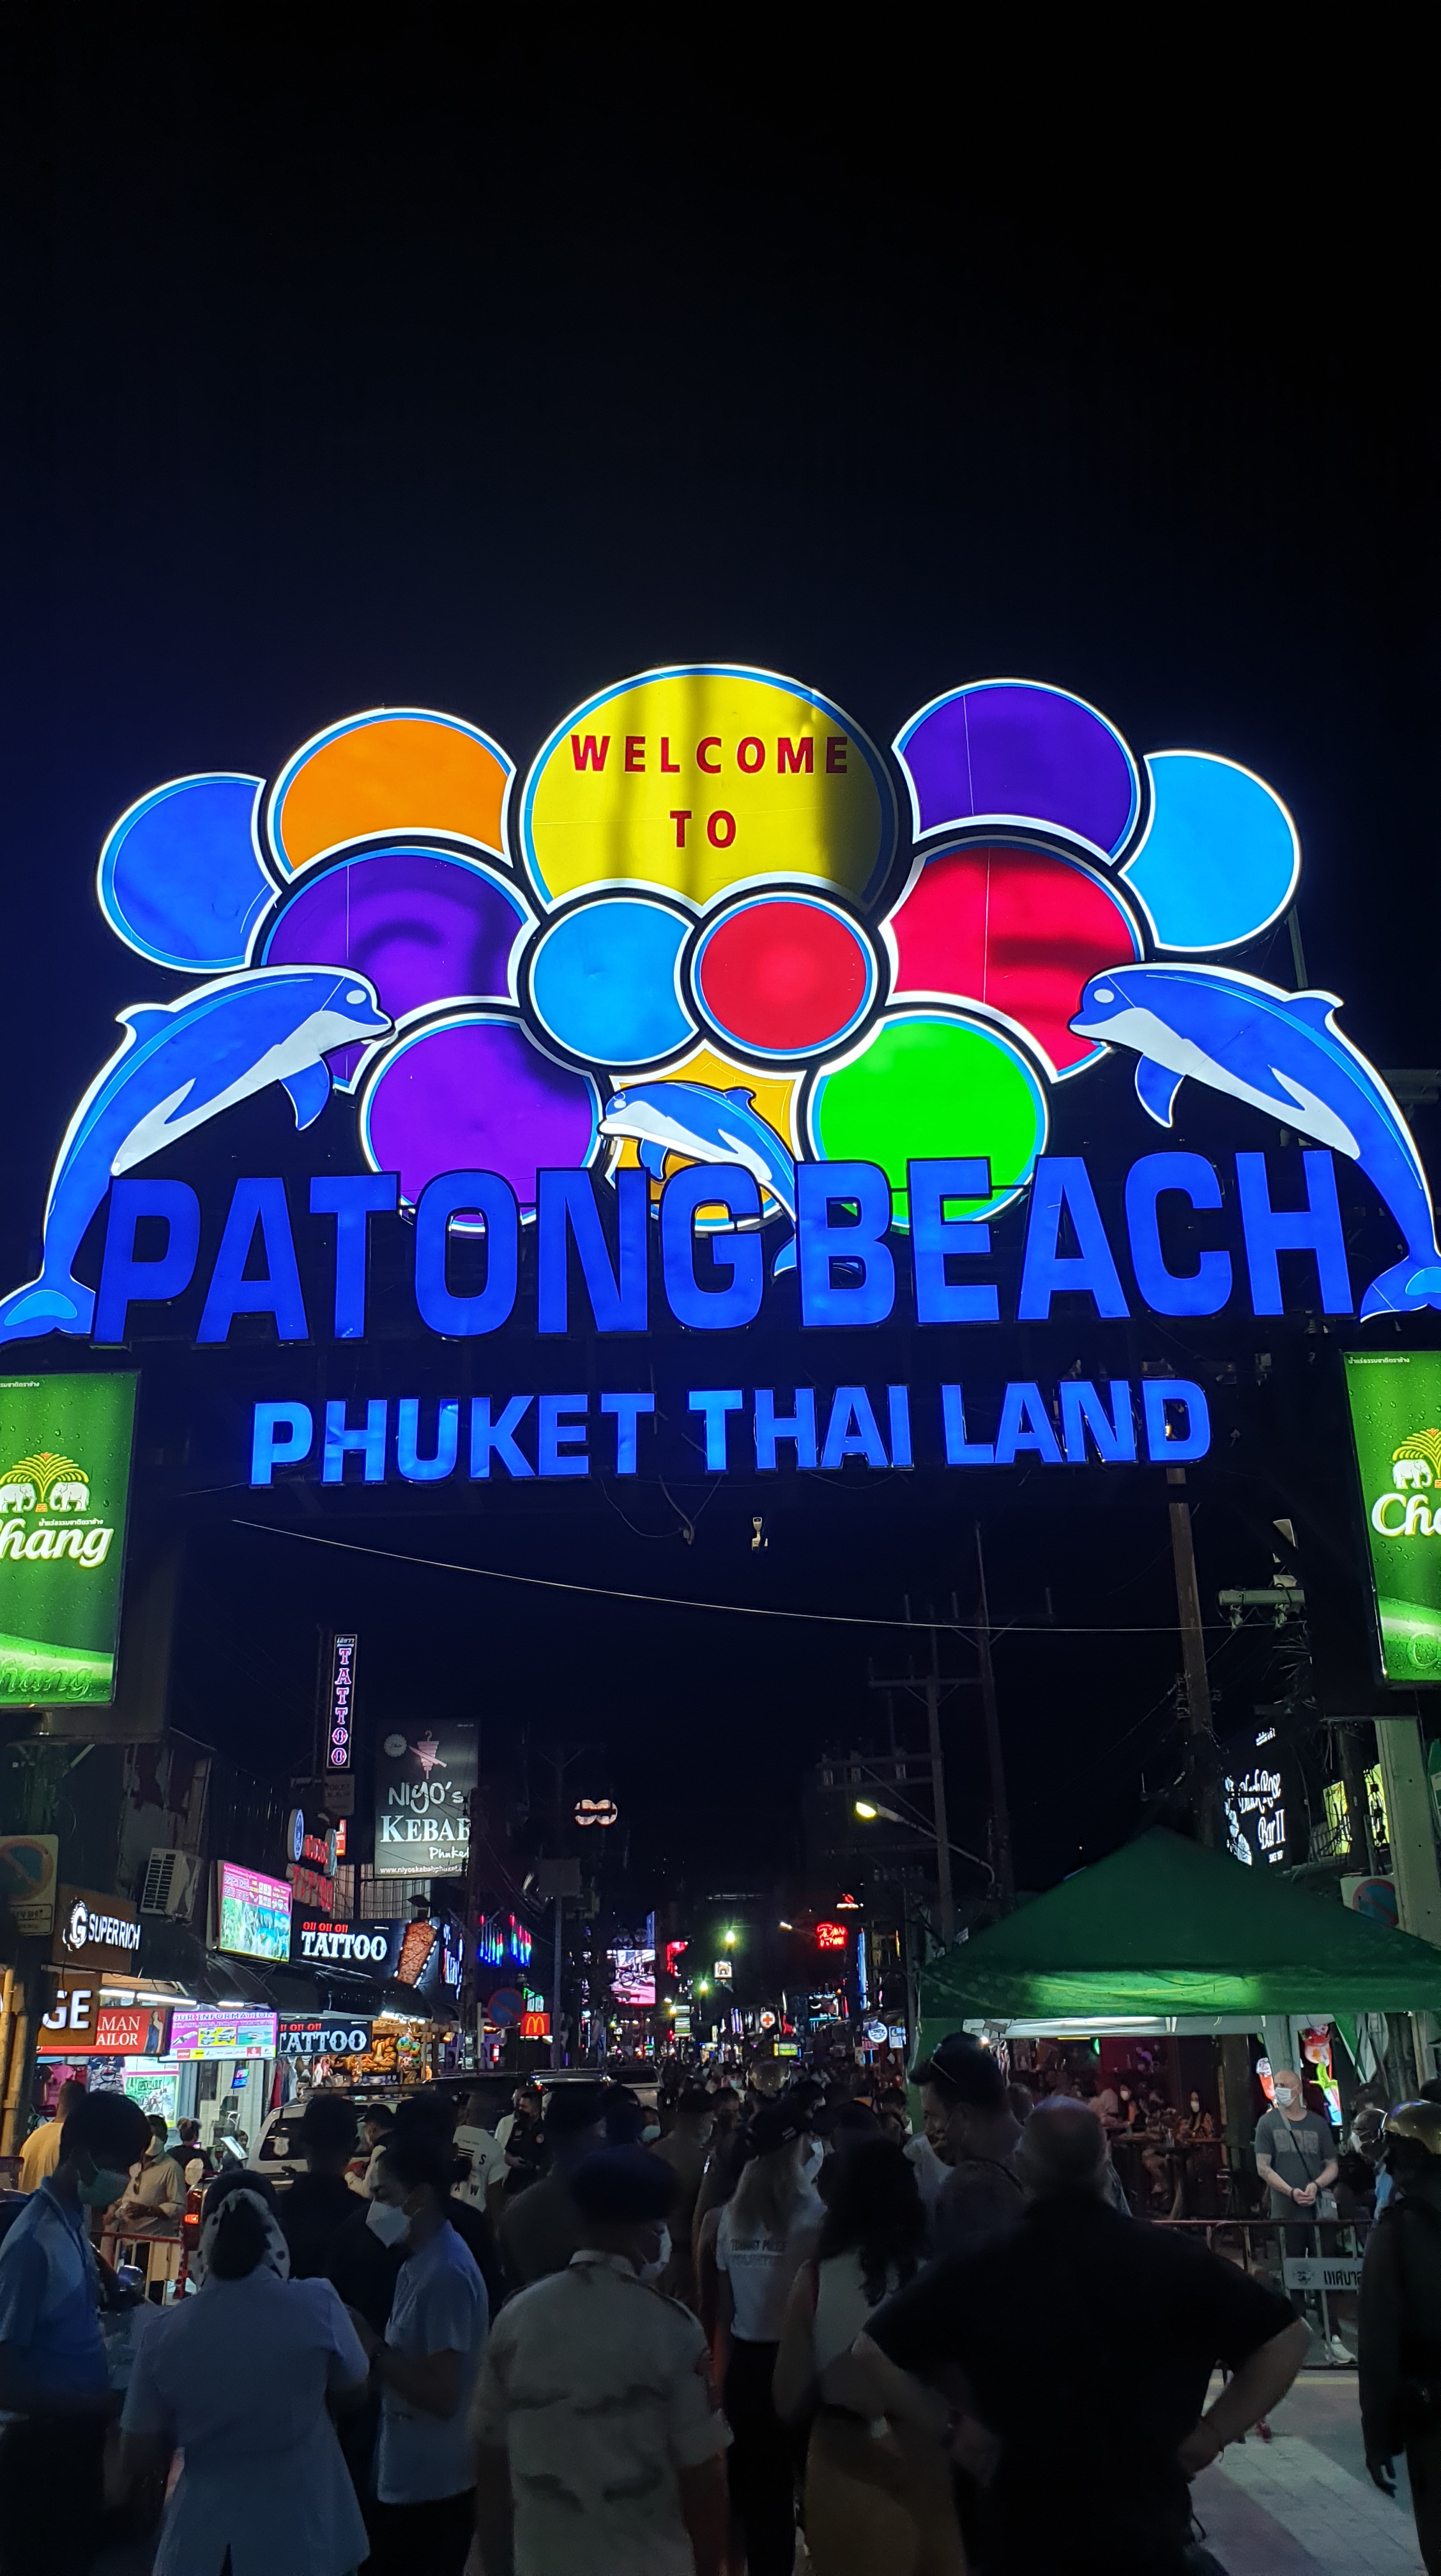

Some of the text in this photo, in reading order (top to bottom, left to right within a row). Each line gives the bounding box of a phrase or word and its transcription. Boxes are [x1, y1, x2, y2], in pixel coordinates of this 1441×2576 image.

[570, 734, 848, 774] WELCOME
[669, 810, 736, 848] TO
[92, 1150, 1355, 1343] PATONG BEACH
[248, 1393, 655, 1485] PHUKET
[1371, 1493, 1441, 1537] Ch
[0, 1518, 114, 1568] hang
[331, 1647, 352, 1766] TATTOO
[380, 1815, 471, 1843] KEBAB
[1258, 1816, 1276, 1850] Bar
[88, 1913, 141, 1951] SUPERRICH
[301, 1930, 388, 1961] TATTOO
[97, 2016, 141, 2031] MAN
[197, 2012, 273, 2021] INFORMATION
[279, 2030, 367, 2053] TATTOO
